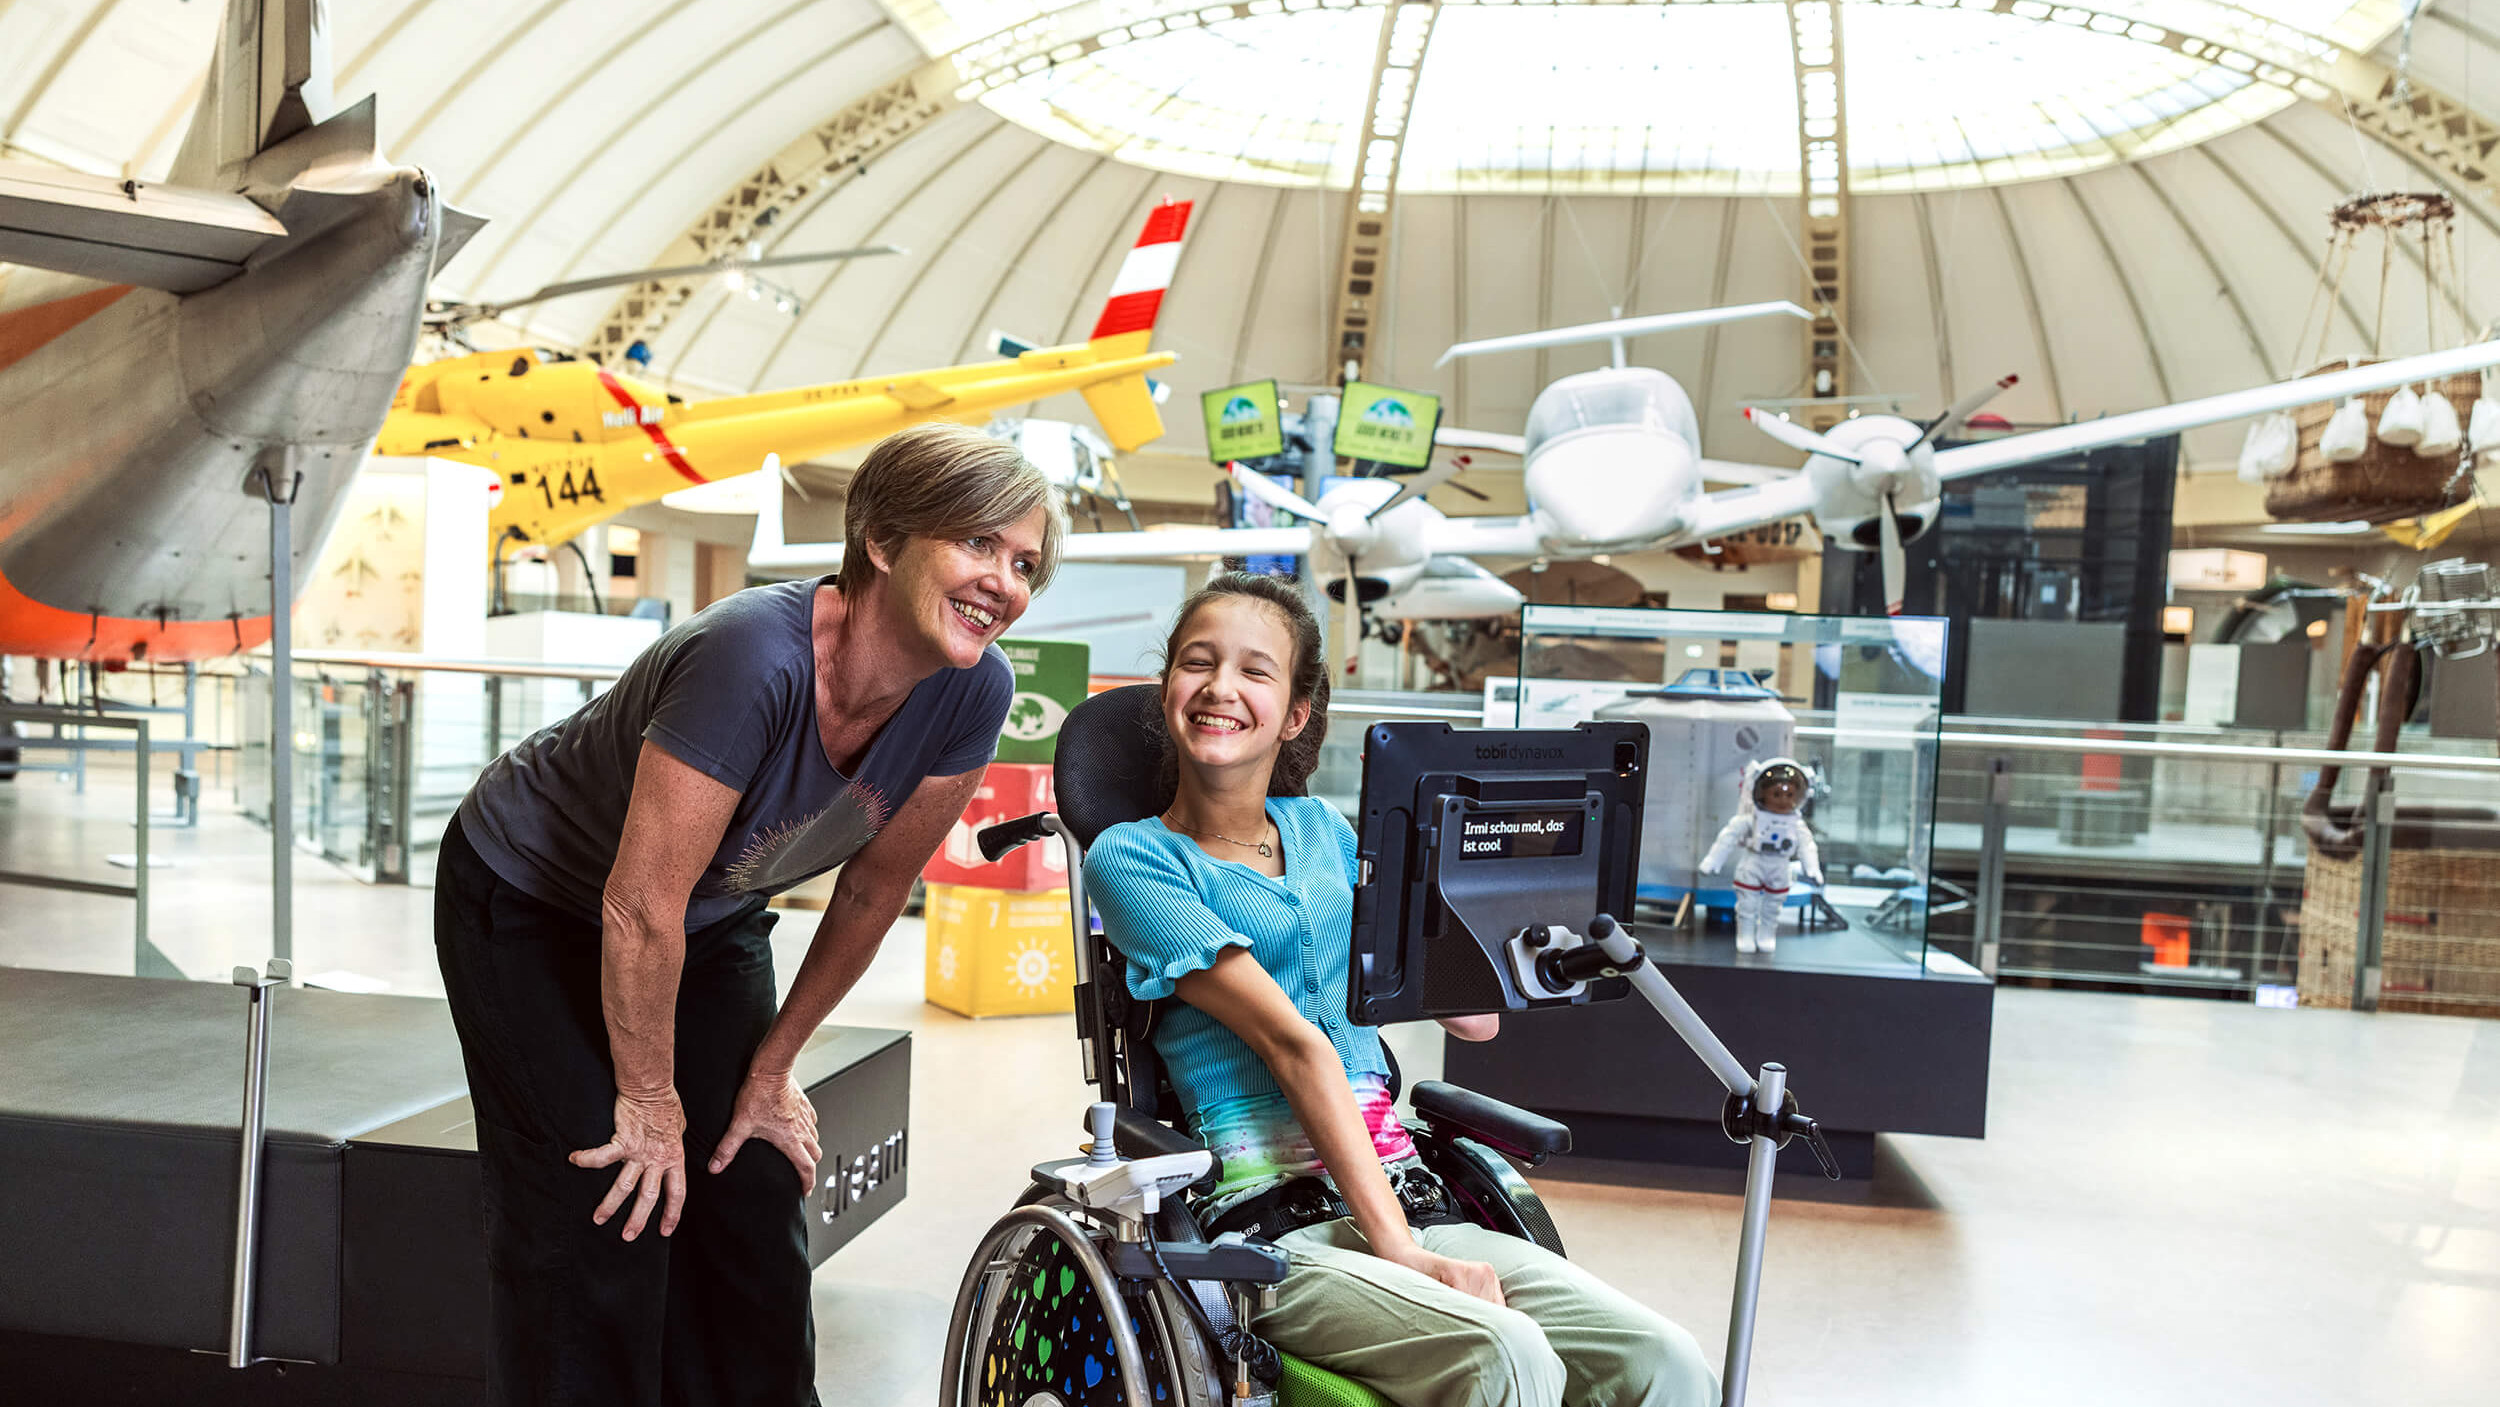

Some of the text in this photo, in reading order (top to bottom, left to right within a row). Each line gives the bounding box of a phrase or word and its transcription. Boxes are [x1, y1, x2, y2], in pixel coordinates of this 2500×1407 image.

[602, 404, 664, 428] Heli Air
[536, 466, 606, 509] 144
[1475, 742, 1565, 764] tobii dynavox
[1464, 819, 1565, 836] Irmi schau mal, das
[1463, 838, 1502, 853] ist cool
[822, 1128, 907, 1225] dream
